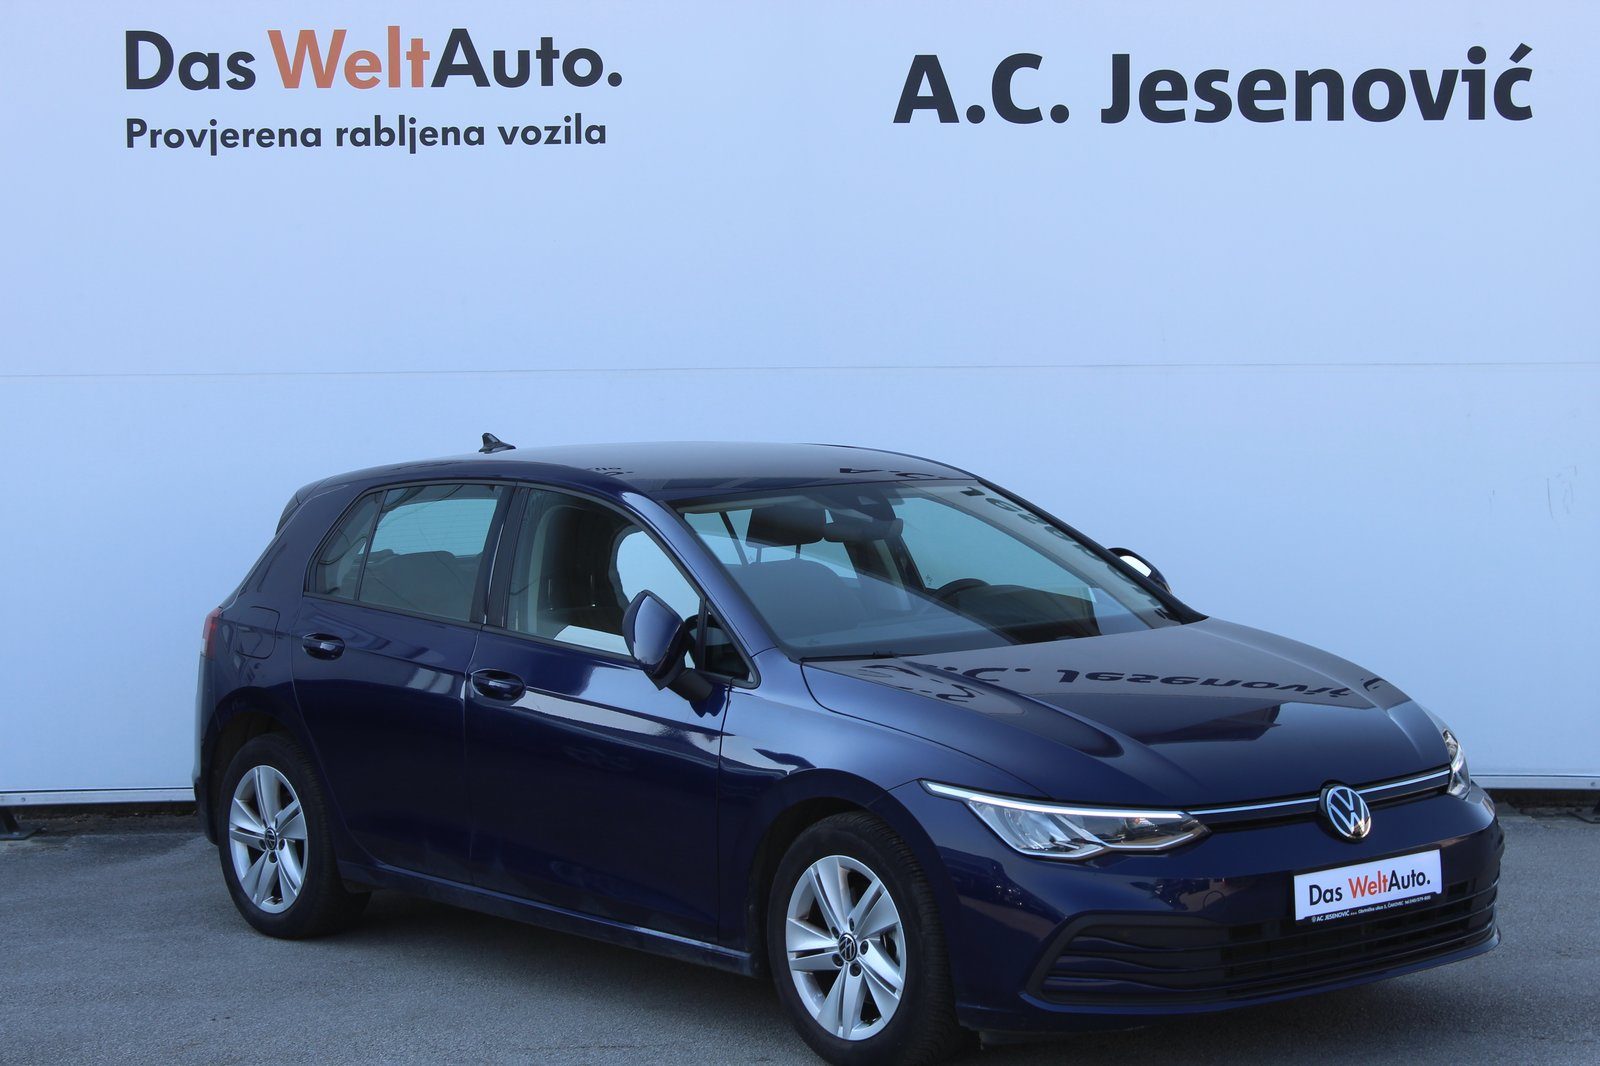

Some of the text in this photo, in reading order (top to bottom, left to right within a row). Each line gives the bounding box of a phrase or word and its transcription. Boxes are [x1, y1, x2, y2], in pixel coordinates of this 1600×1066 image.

[126, 26, 622, 90] Das WeltAuto.
[893, 43, 1533, 124] A.C. Jesenović
[127, 113, 606, 156] Provjerena rabljena vozila
[1309, 869, 1431, 906] Das WeltAuto.
